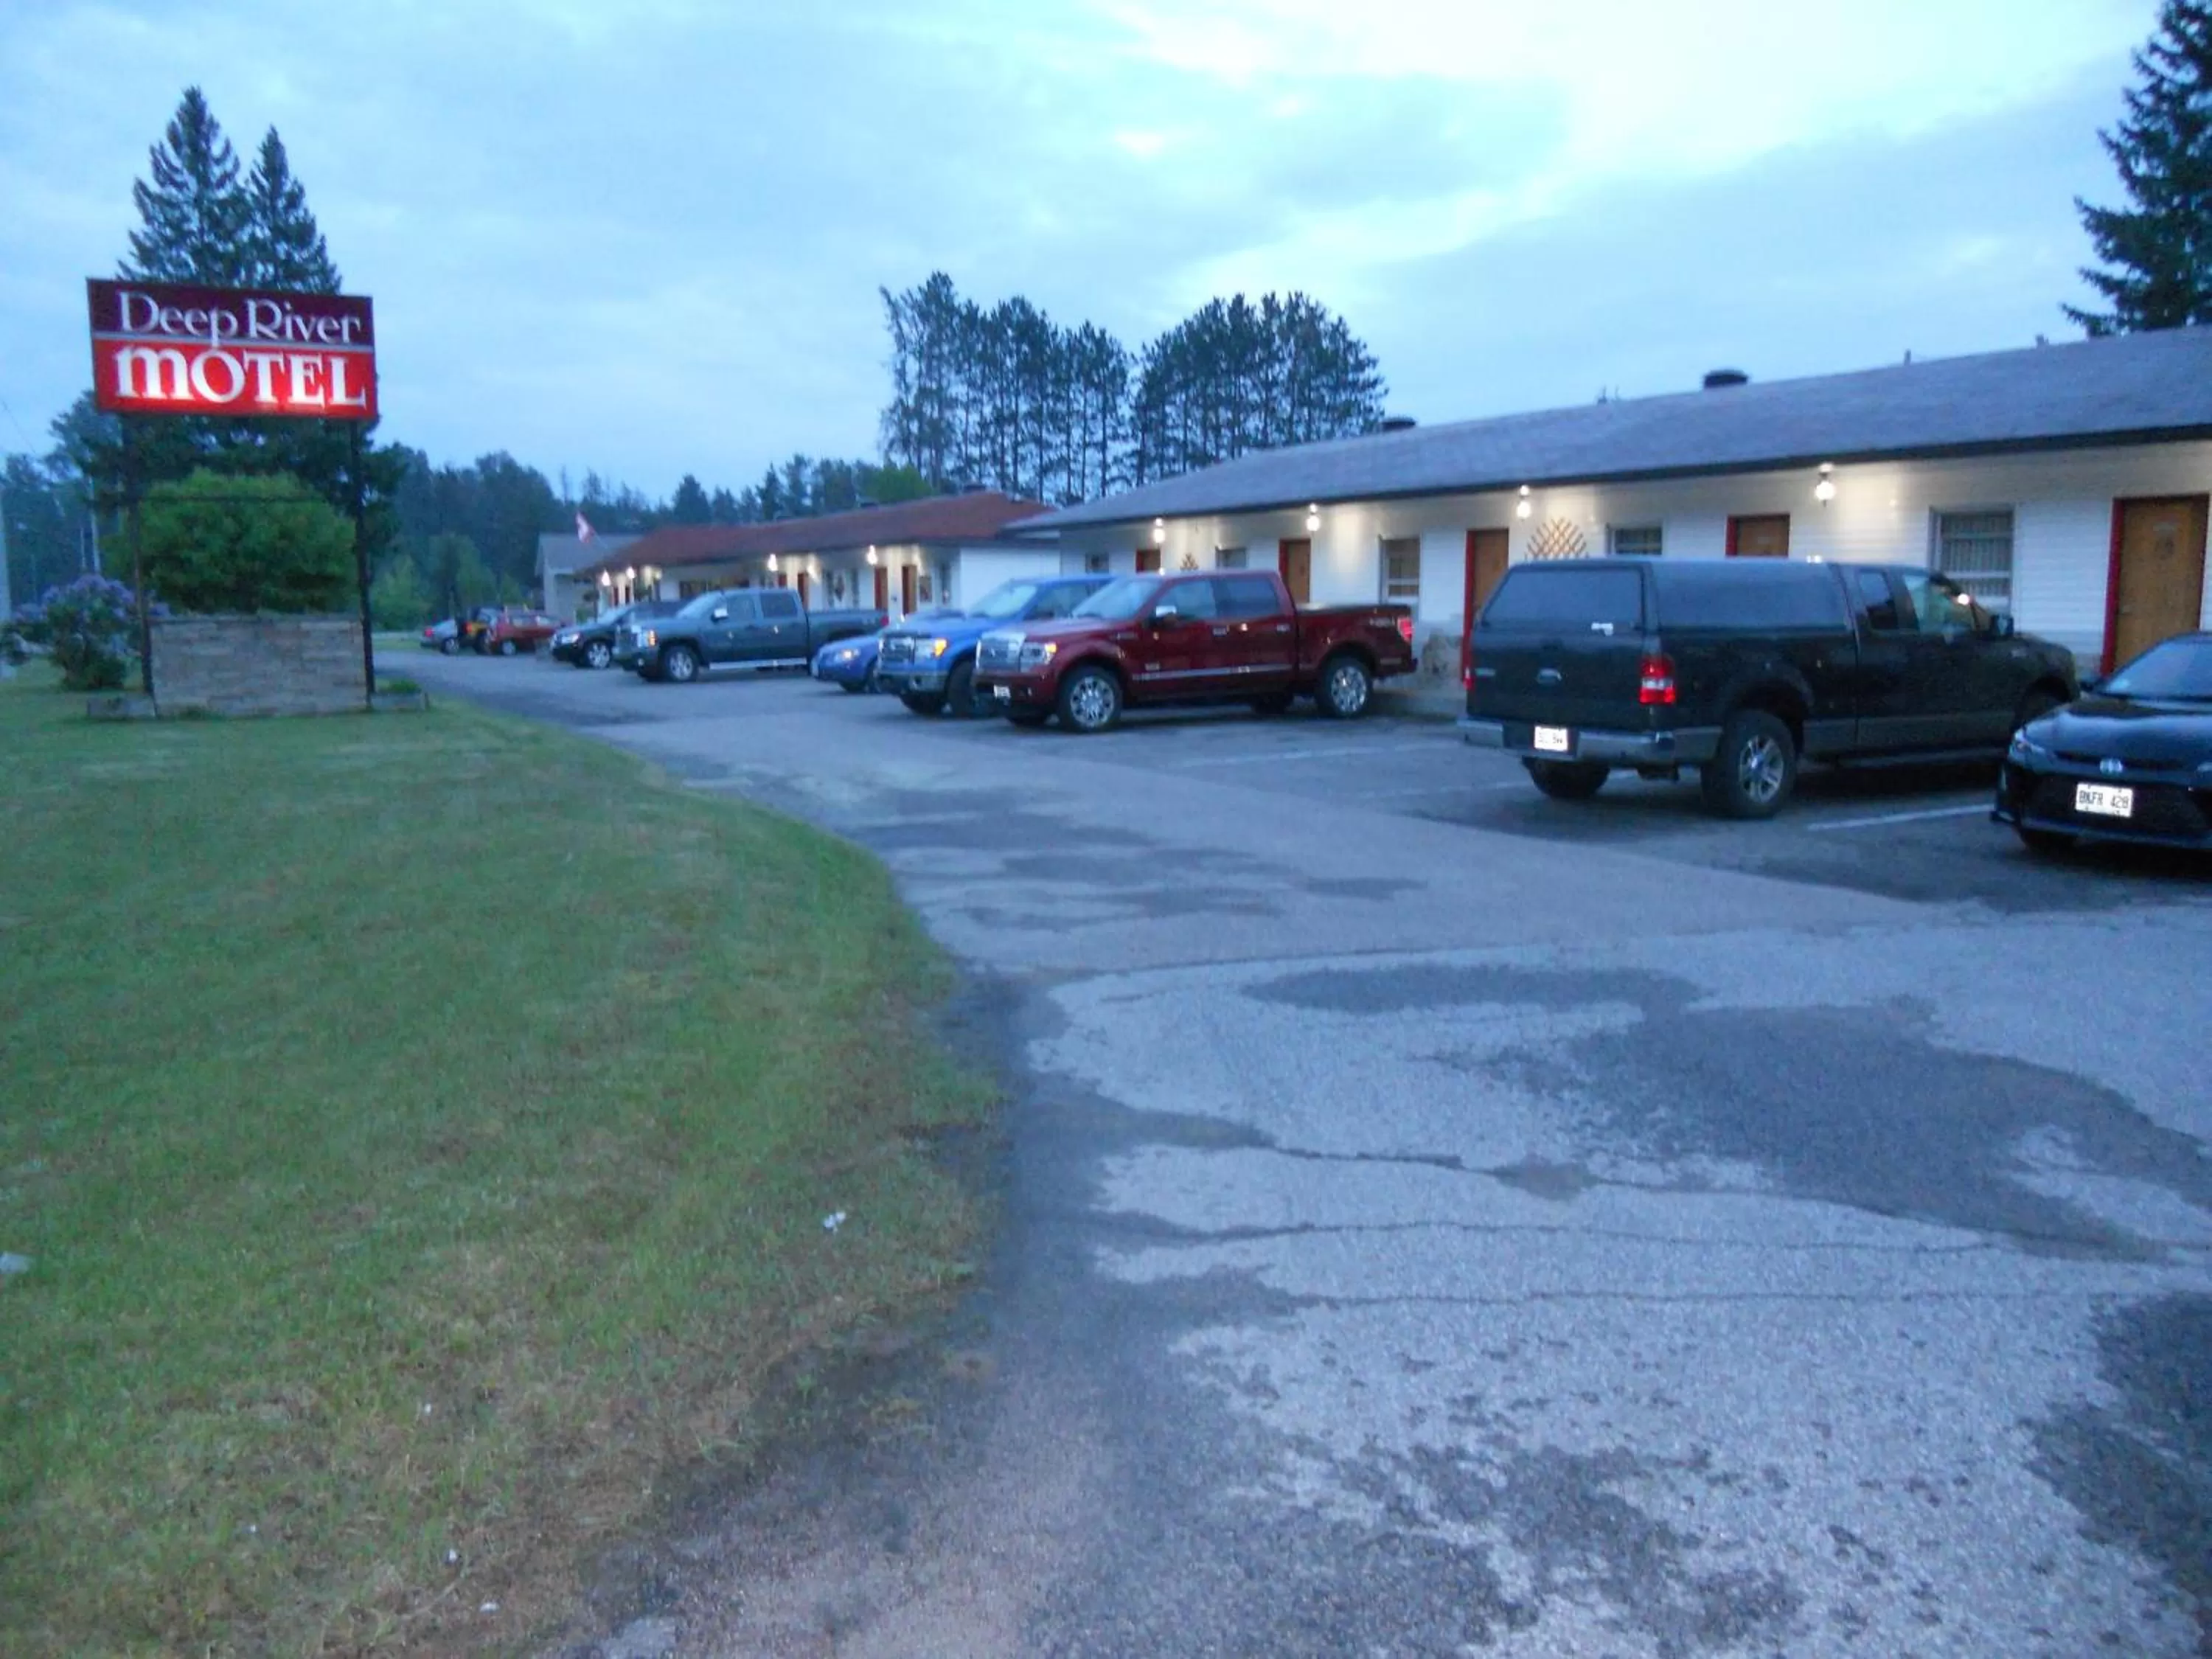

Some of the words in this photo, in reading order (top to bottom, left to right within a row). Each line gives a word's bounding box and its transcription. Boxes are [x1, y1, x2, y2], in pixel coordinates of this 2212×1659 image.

[116, 292, 239, 348] Deep
[246, 298, 361, 344] River
[114, 345, 368, 409] MOTEL
